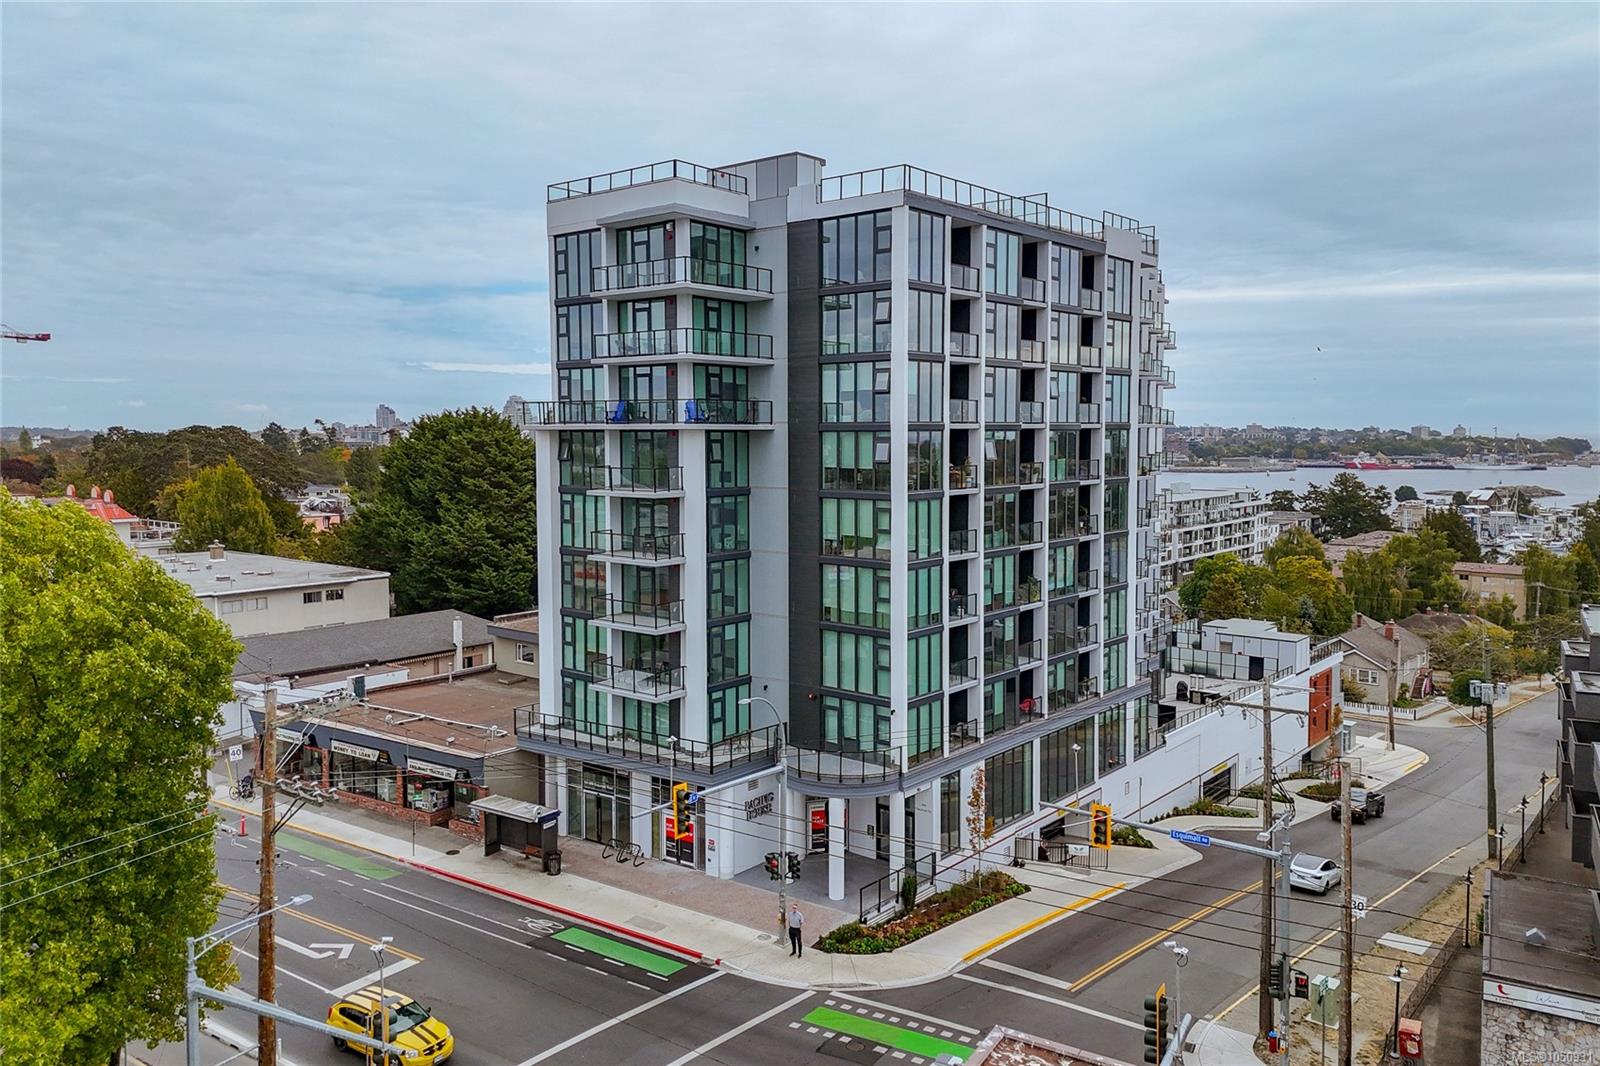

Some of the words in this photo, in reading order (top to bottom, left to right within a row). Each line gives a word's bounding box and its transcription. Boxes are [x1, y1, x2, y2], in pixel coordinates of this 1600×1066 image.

[231, 749, 241, 757] 40
[1172, 831, 1201, 842] Esquimalt
[1352, 900, 1364, 911] 30
